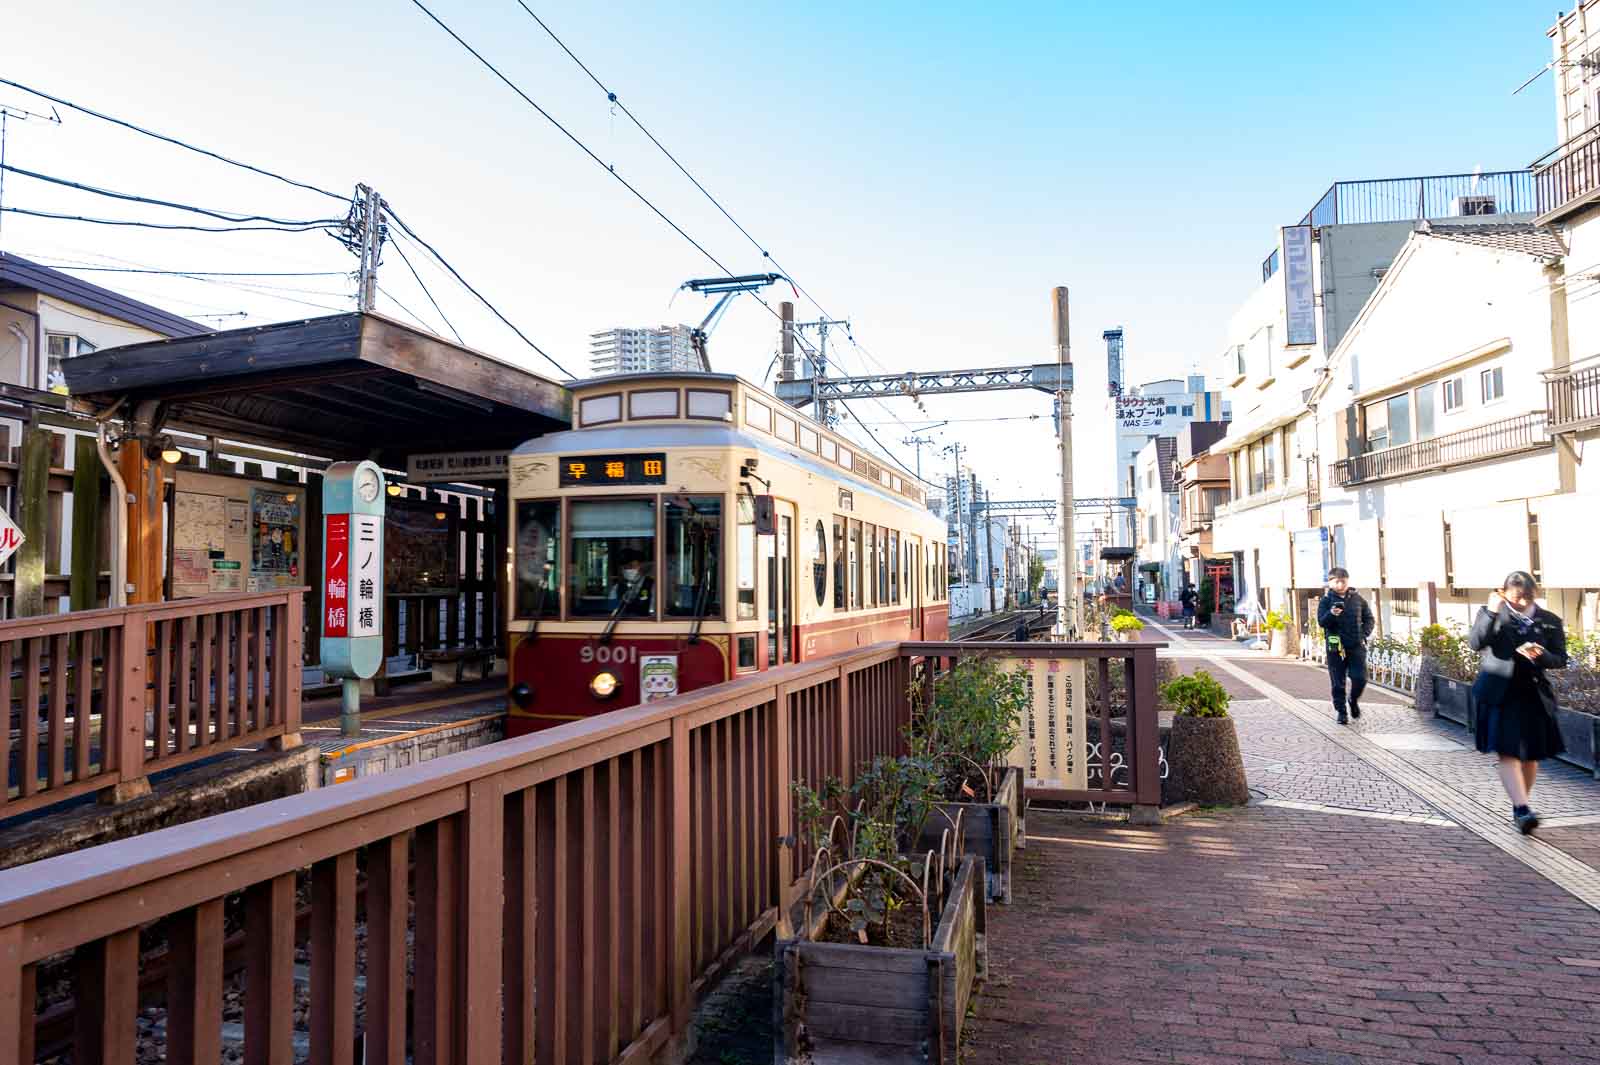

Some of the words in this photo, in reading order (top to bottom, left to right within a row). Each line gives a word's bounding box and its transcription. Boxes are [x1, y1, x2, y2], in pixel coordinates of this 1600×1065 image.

[1115, 408, 1165, 419] 温水プール
[1123, 419, 1140, 427] NAS
[568, 460, 662, 478] 早稲田
[328, 522, 347, 628] 三ノ輪橋
[360, 522, 374, 628] 三ノ輪橋
[581, 646, 637, 664] 9001
